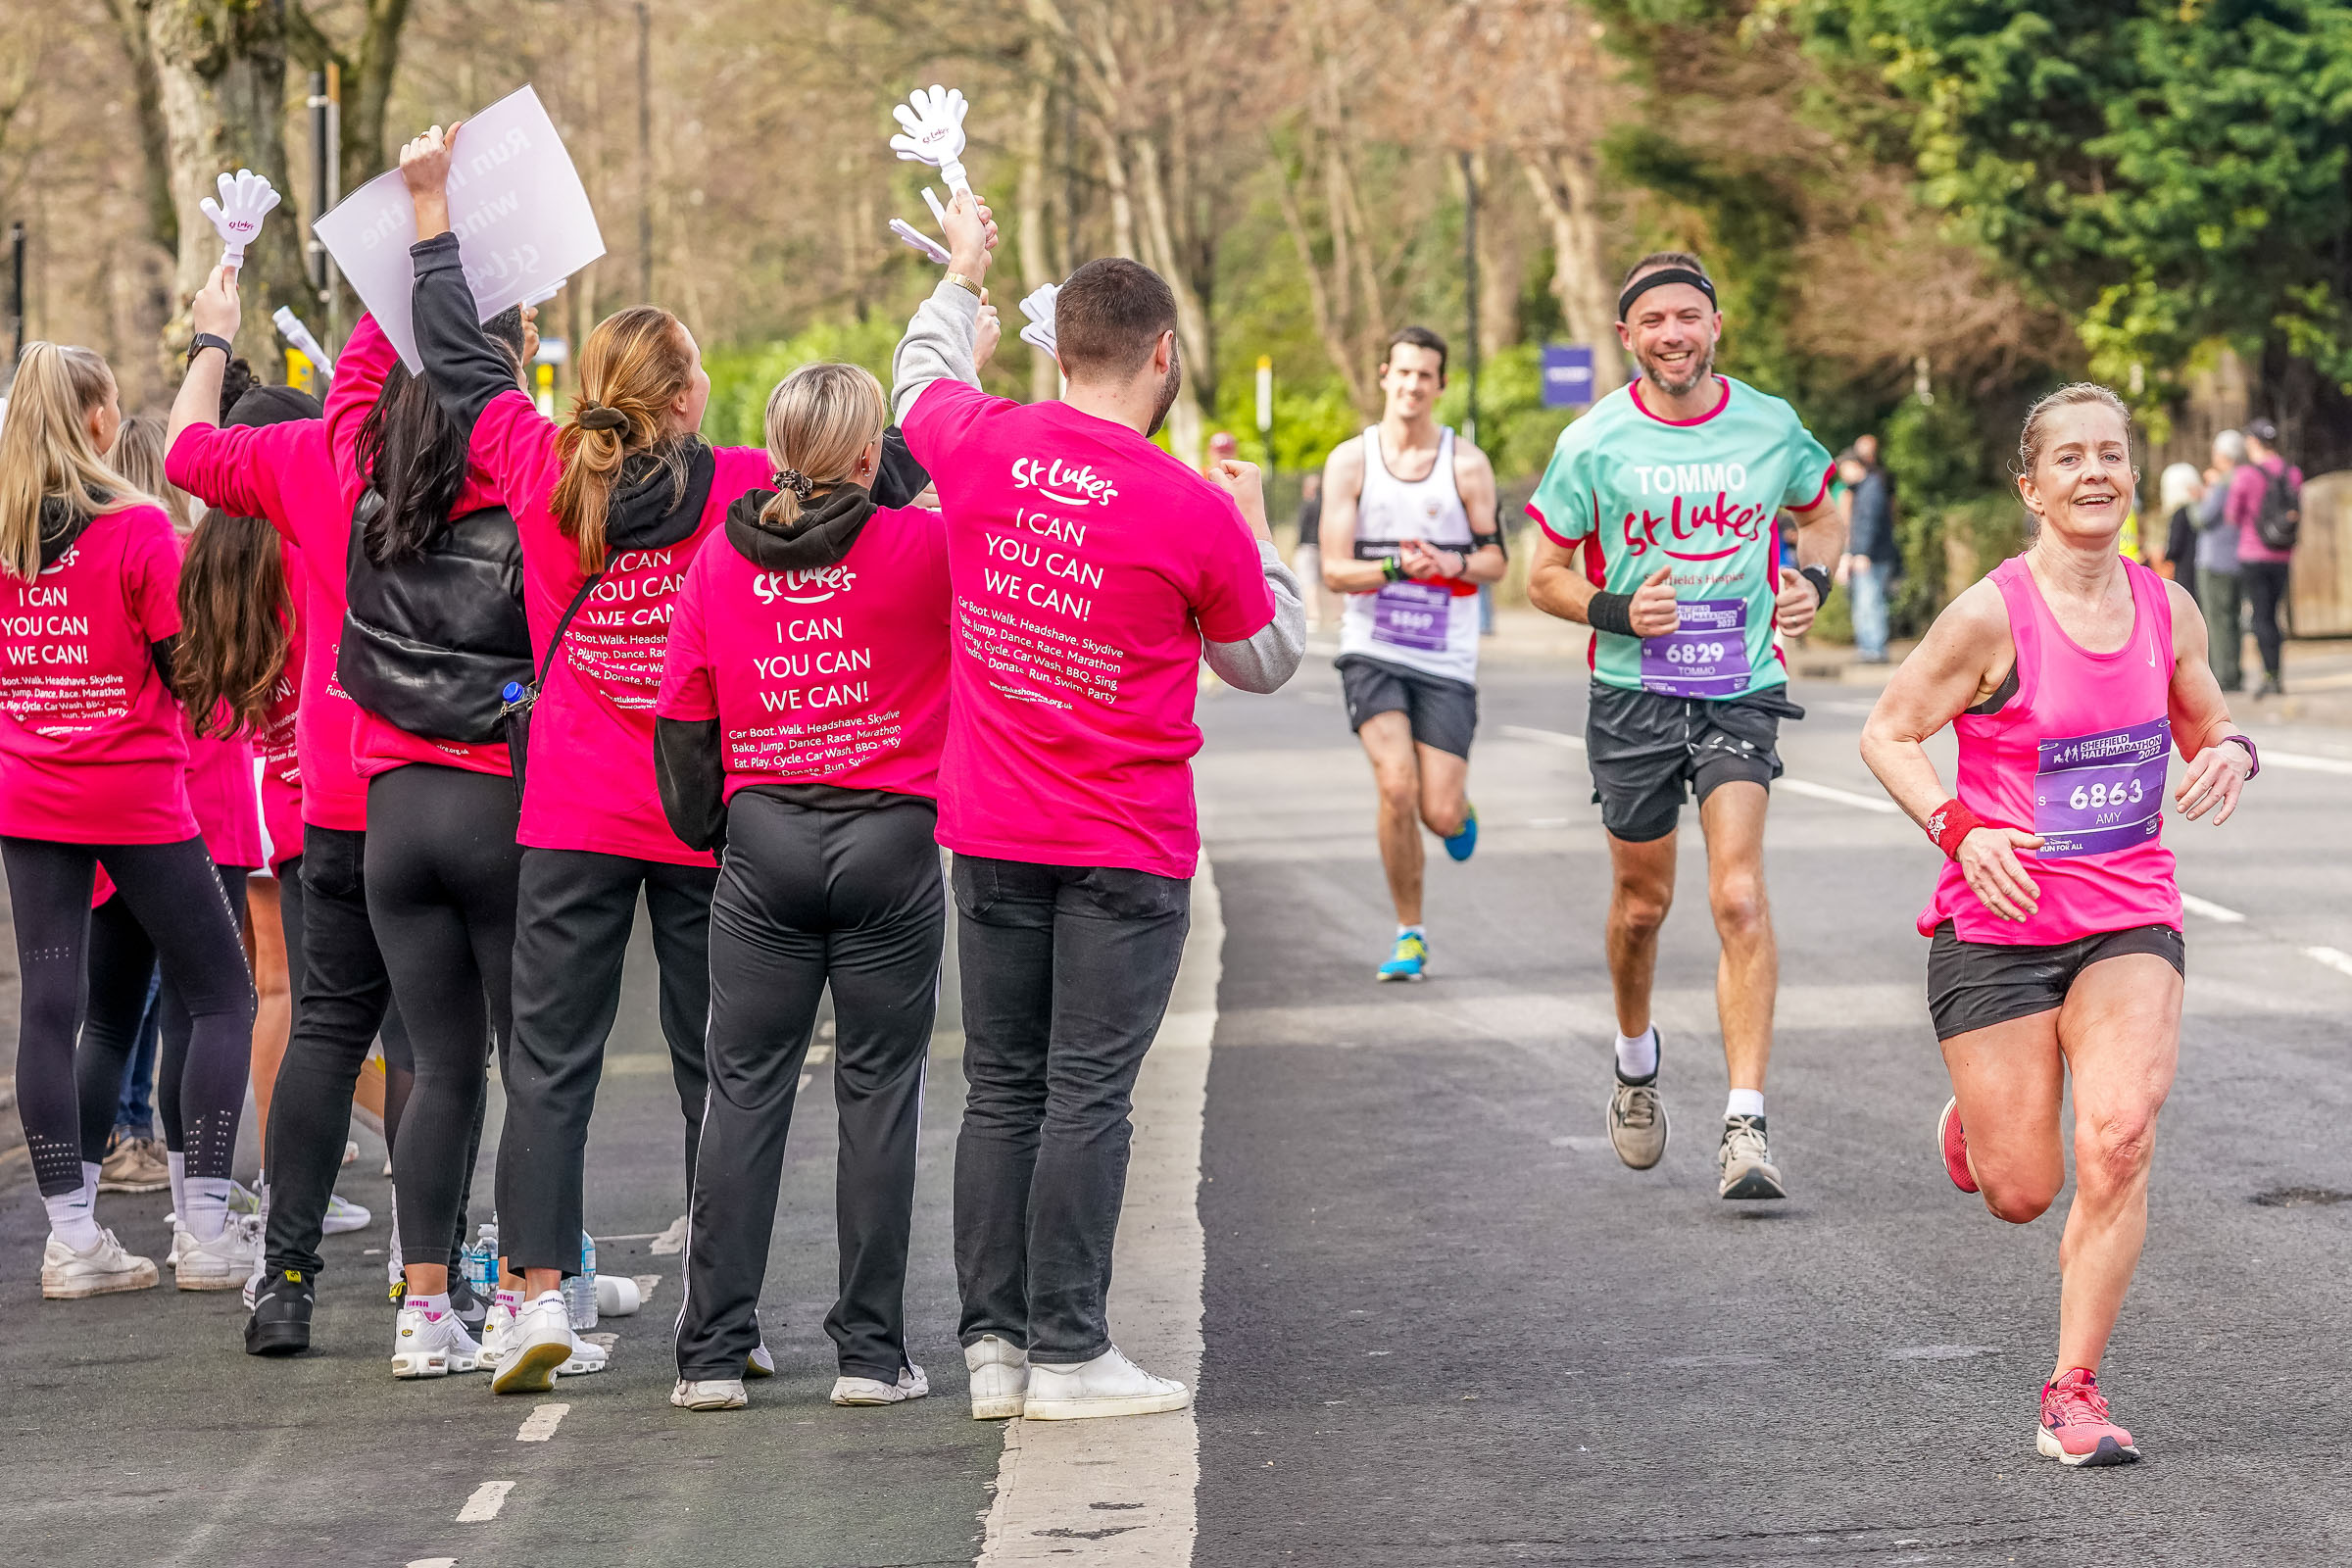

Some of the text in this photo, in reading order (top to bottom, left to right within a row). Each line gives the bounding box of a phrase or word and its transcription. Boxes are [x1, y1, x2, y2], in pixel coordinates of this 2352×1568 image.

[1011, 457, 1119, 507] St Luke's
[1635, 463, 1746, 495] TOMMO
[1015, 507, 1087, 548] I CAN
[1624, 491, 1766, 557] St Luke's
[619, 550, 672, 572] CAN
[985, 532, 1104, 590] YOU CAN
[19, 586, 68, 608] I CAN
[753, 564, 857, 605] St Luke's
[984, 567, 1092, 622] WE CAN!
[0, 615, 88, 637] YOU CAN
[588, 611, 625, 626] WE
[776, 616, 843, 644] I CAN
[958, 595, 1124, 659] Car Boot. Walk. Headshave. Skydive
[575, 631, 599, 644] Boot.
[599, 635, 627, 646] Walk.
[629, 634, 668, 645] Headsh
[1000, 628, 1034, 649] Dance.
[1037, 640, 1064, 659] Race.
[1066, 650, 1121, 673] Marathon
[7, 644, 89, 666] WE CAN!
[612, 650, 647, 660] Dance.
[753, 648, 871, 680] YOU CAN
[984, 640, 1010, 658] Cycle.
[1012, 649, 1033, 663] Car
[1034, 654, 1064, 673] Wash.
[1066, 666, 1092, 684] BBQ.
[1095, 674, 1118, 692] Sing
[1666, 642, 1725, 664] 6829
[89, 673, 123, 687] Skydive
[629, 662, 648, 672] Car
[82, 686, 126, 697] Marathon
[760, 681, 869, 712] WE CAN!
[1029, 667, 1053, 684] Run.
[1054, 676, 1086, 695] Swim.
[1088, 687, 1117, 705] Party
[728, 729, 747, 741] Car
[750, 726, 777, 738] Boot.
[777, 724, 805, 736] Walk.
[807, 716, 865, 734] Headshave.
[732, 724, 901, 754] Bake. Jump. Dance. Race. Marathon
[2081, 734, 2129, 752] SHEFFIELD
[2081, 734, 2162, 760] HALF MARATHON
[2138, 745, 2161, 760] 2022
[734, 758, 750, 769] Eat.
[751, 756, 771, 769] Play.
[773, 751, 804, 766] Cycle.
[806, 751, 823, 762] Car
[825, 745, 855, 759] Wash.
[2037, 796, 2046, 807] S
[2069, 778, 2143, 810] 6863
[2095, 811, 2123, 825] AMY
